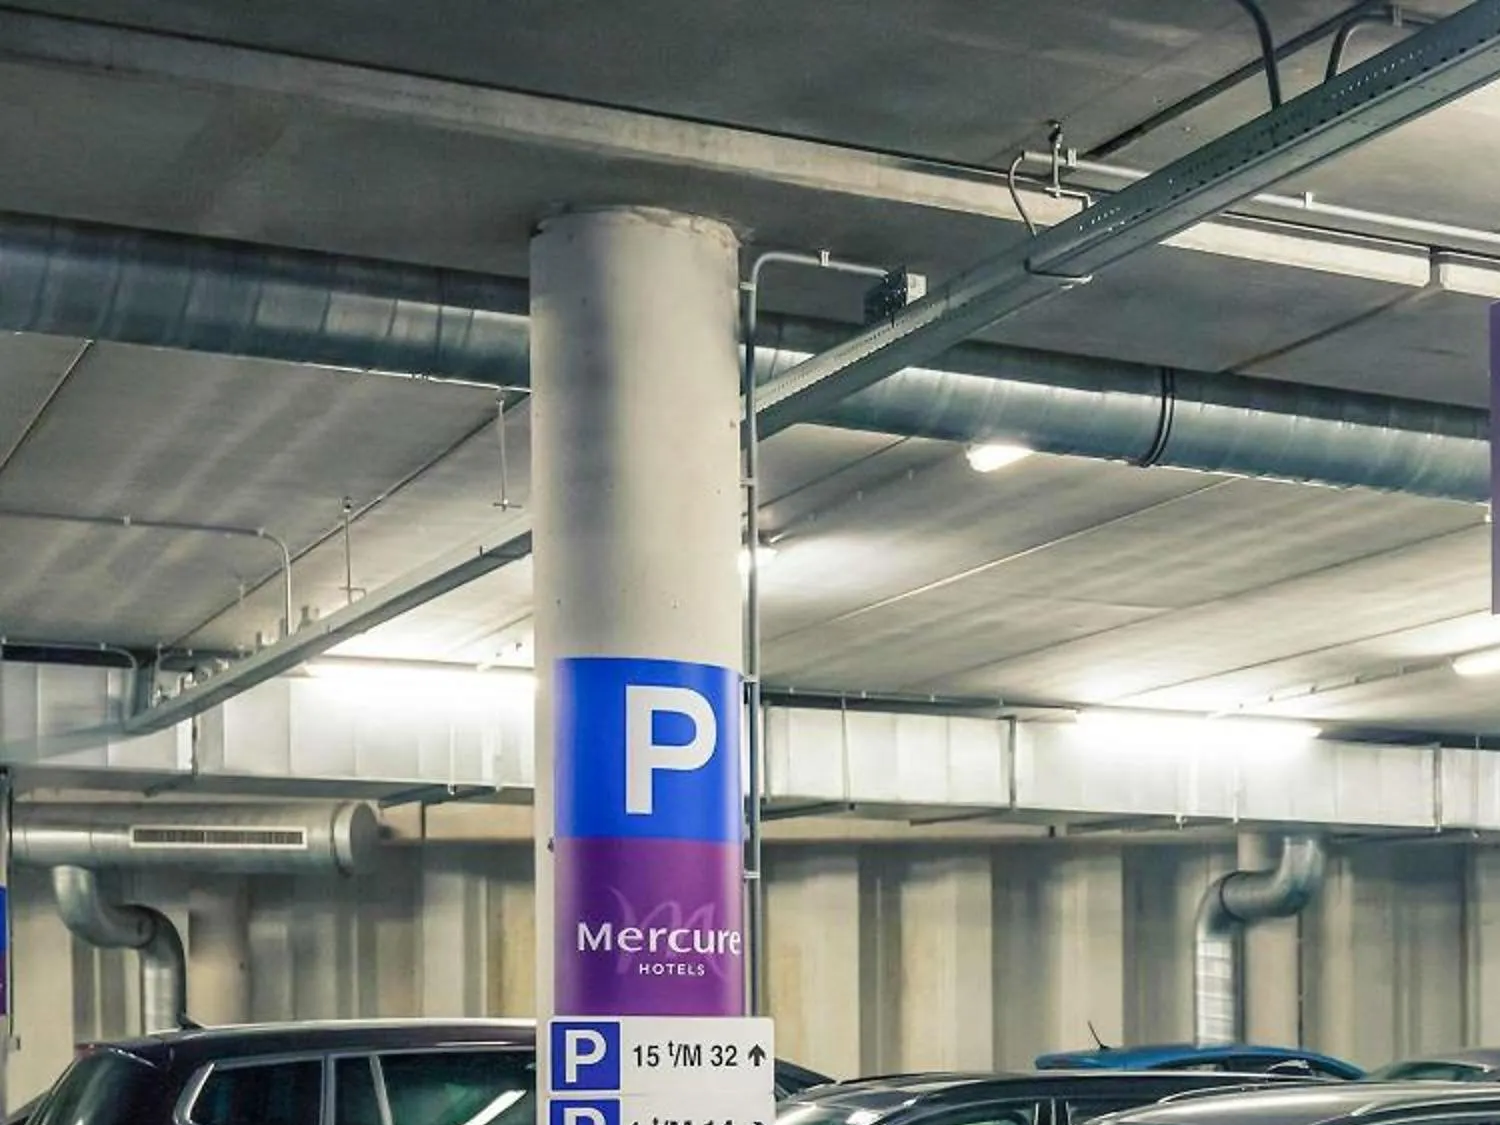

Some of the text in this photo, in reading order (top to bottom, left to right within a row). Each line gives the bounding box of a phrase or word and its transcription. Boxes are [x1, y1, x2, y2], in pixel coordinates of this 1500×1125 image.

[625, 684, 717, 815] P
[577, 921, 742, 956] Mercure
[639, 963, 705, 976] HOTELS
[564, 1029, 607, 1083] P
[633, 1045, 660, 1067] 15
[710, 1045, 738, 1067] 32
